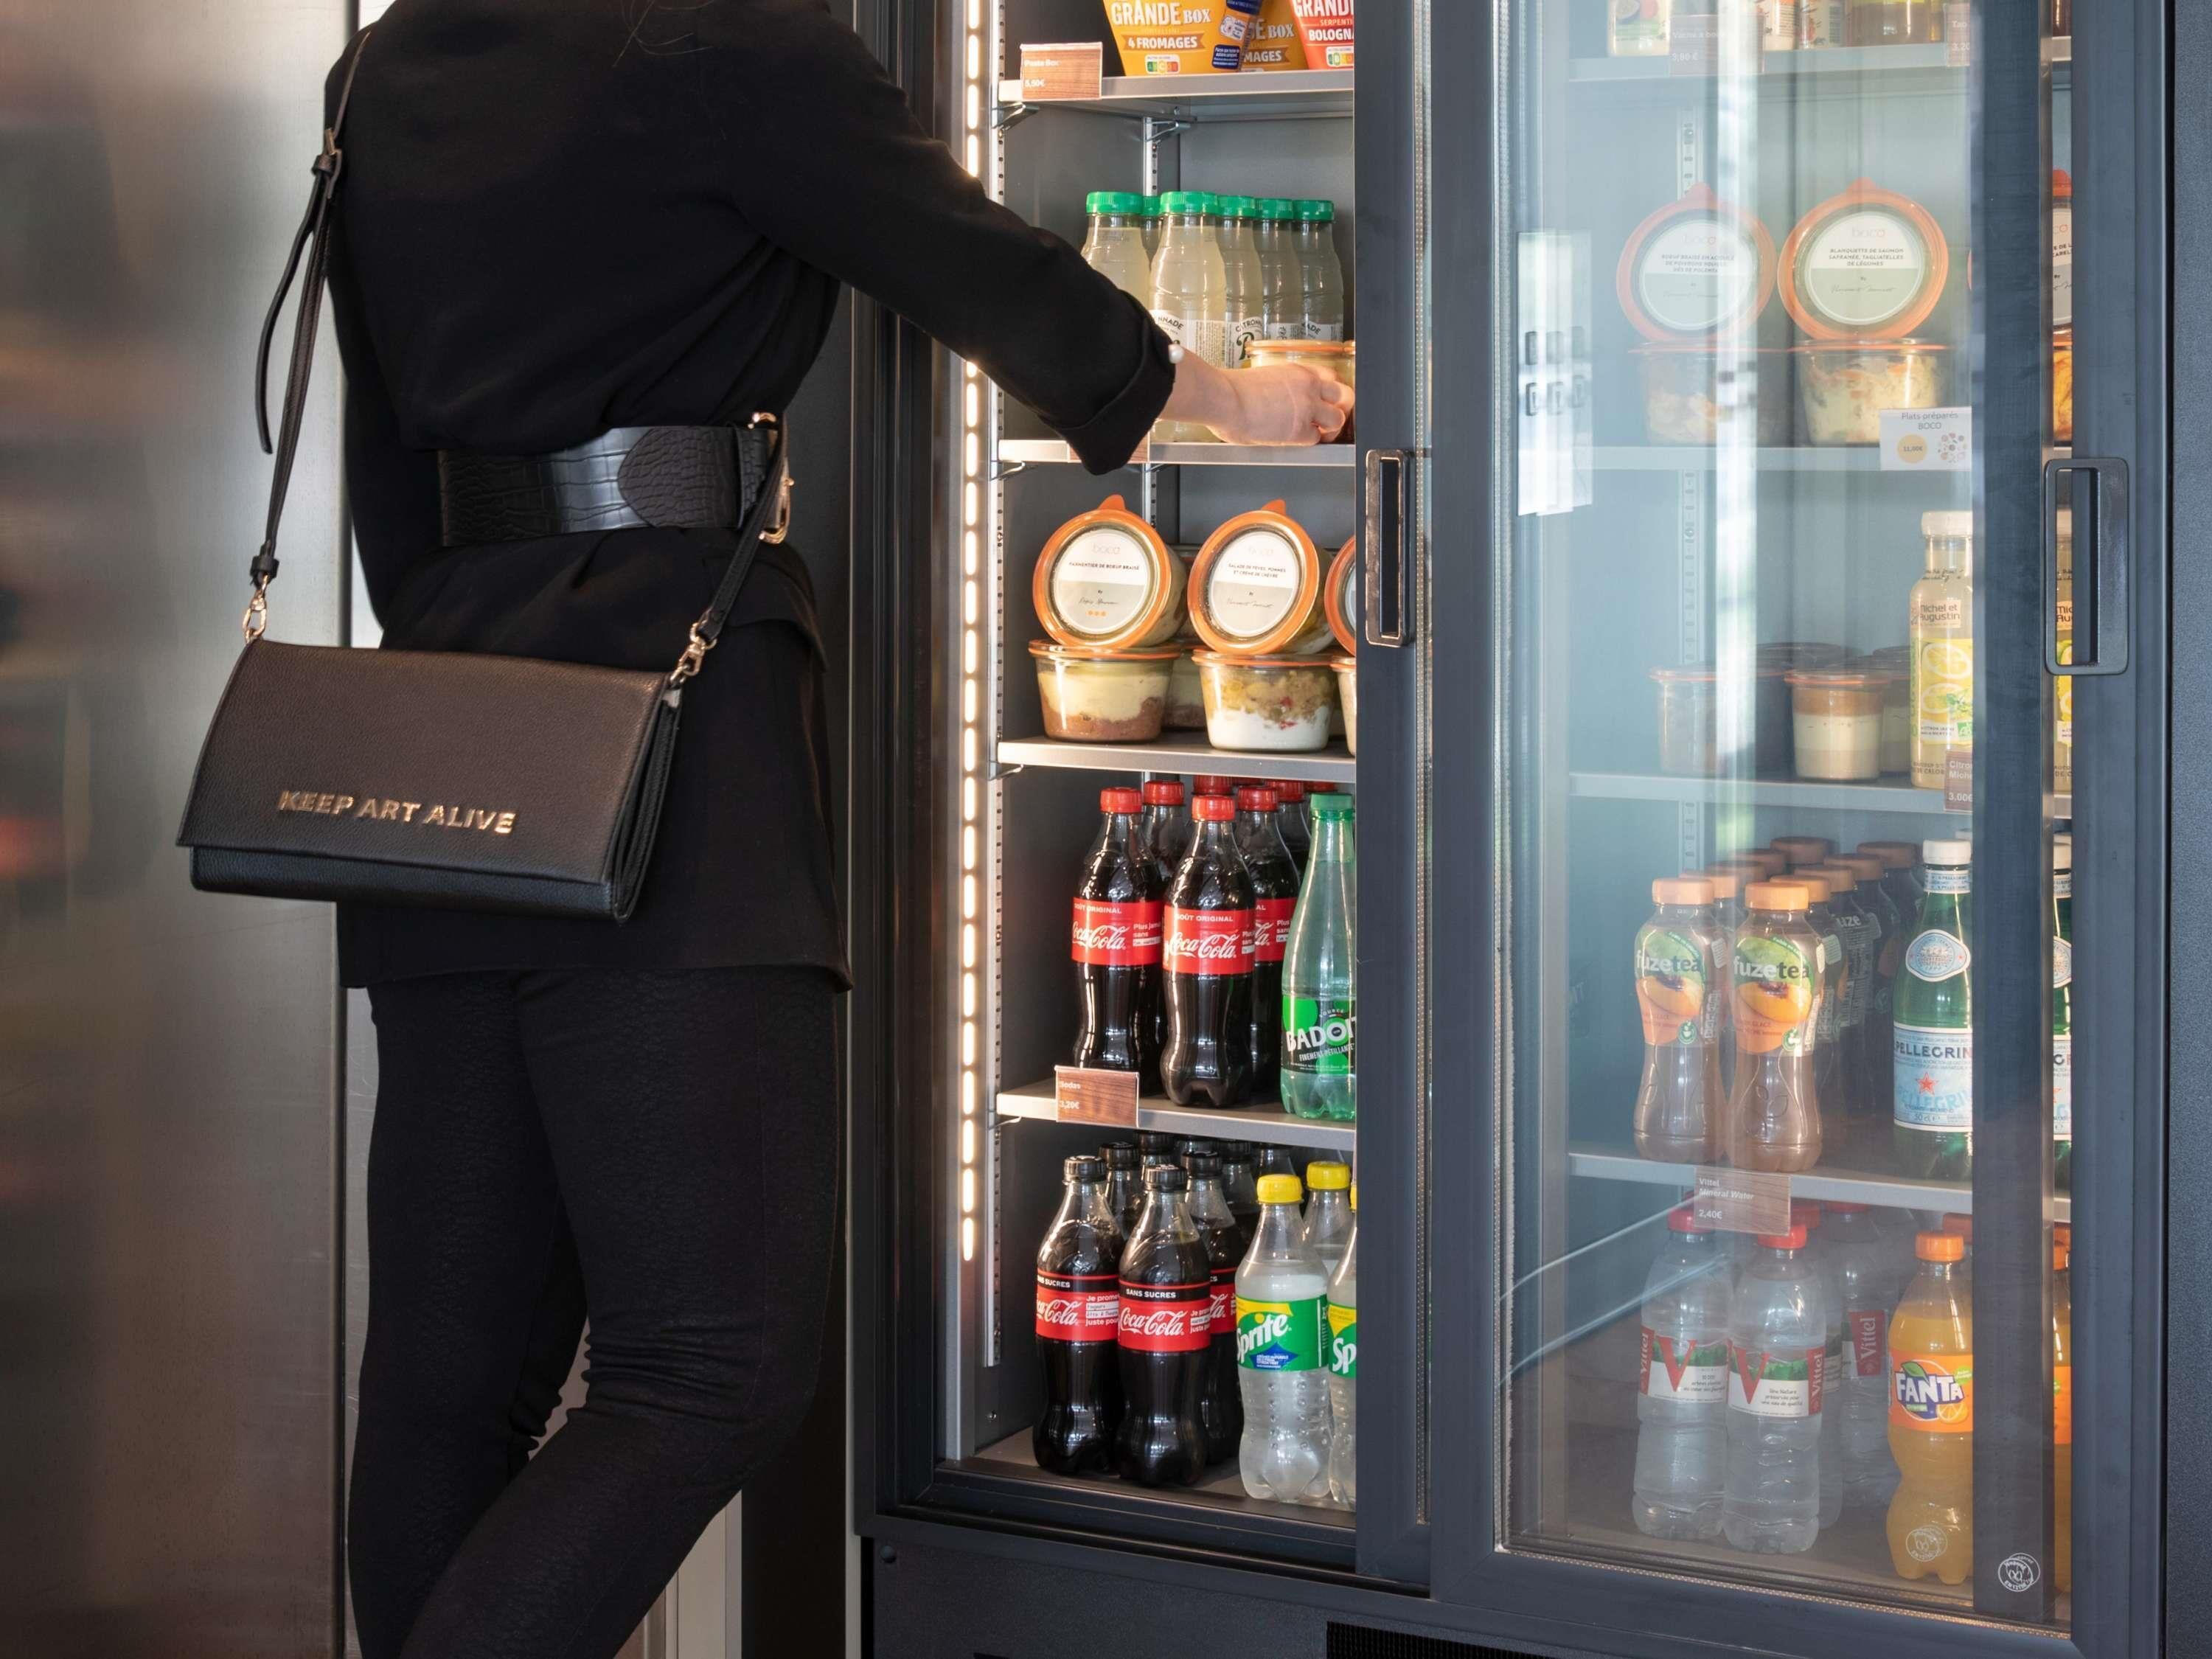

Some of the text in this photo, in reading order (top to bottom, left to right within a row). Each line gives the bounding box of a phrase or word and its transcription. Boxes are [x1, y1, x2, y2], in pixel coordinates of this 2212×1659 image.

[1111, 1, 1211, 26] GRANDE BOX
[1267, 24, 1294, 39] BOX
[1127, 36, 1197, 49] 4 FROMAGES
[1922, 411, 1959, 420] préparés
[1918, 422, 1942, 430] BOCO
[278, 789, 516, 835] KEEP ART ALIVE
[1086, 905, 1122, 914] ORIGINAL
[1169, 931, 1240, 959] Coca-Cola
[1698, 1178, 1719, 1186] Vittel
[1698, 1188, 1754, 1200] Mineral Water
[1698, 1209, 1723, 1220] 2,40€
[1045, 1279, 1071, 1288] SUCRES
[1126, 1289, 1176, 1298] SANS SUCRES
[1120, 1307, 1189, 1336] Coca-Cola
[1237, 1314, 1289, 1364] Sprite
[1861, 1317, 1877, 1359] Vittel
[1640, 1332, 1649, 1374] Vittel
[1811, 1353, 1823, 1397] Vittel
[1896, 1372, 1964, 1403] FANTA
